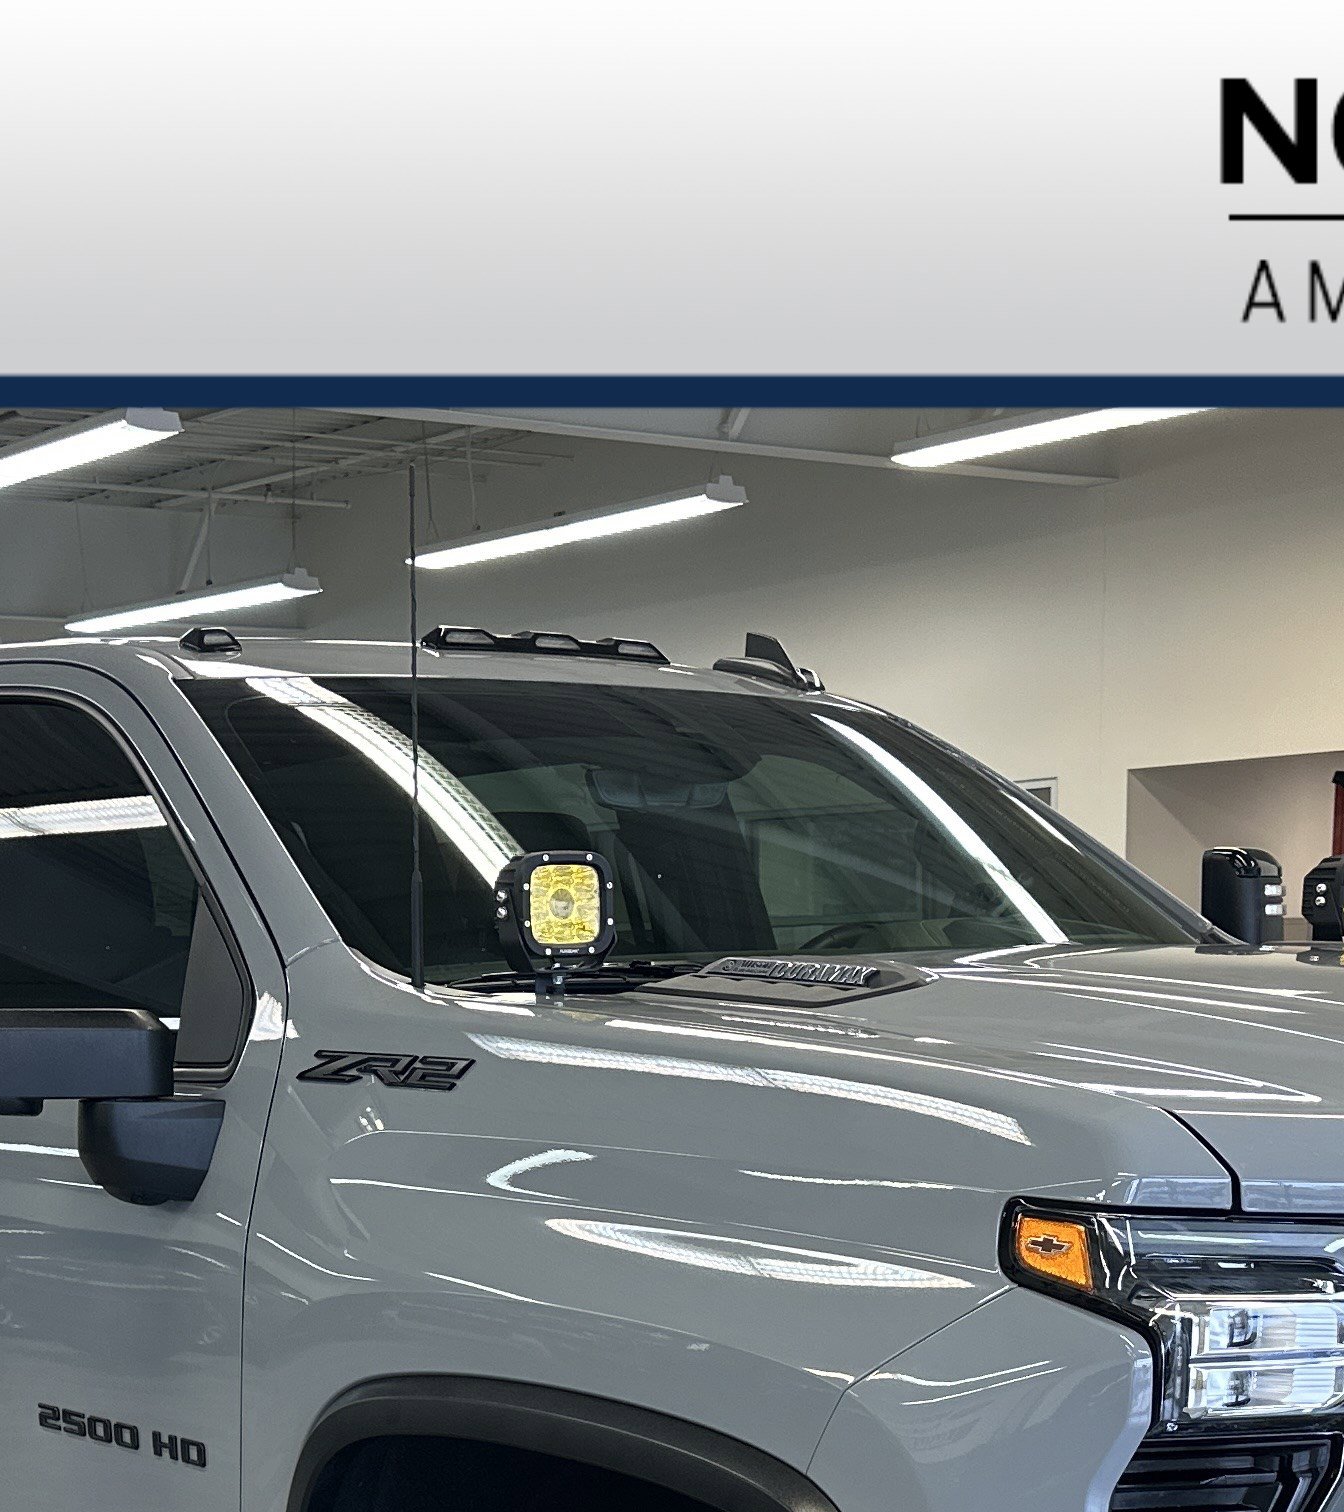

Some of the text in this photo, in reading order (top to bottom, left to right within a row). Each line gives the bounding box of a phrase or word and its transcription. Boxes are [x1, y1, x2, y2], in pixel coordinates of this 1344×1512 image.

[295, 1050, 477, 1091] ZR2
[38, 1402, 207, 1468] 2500 HD
